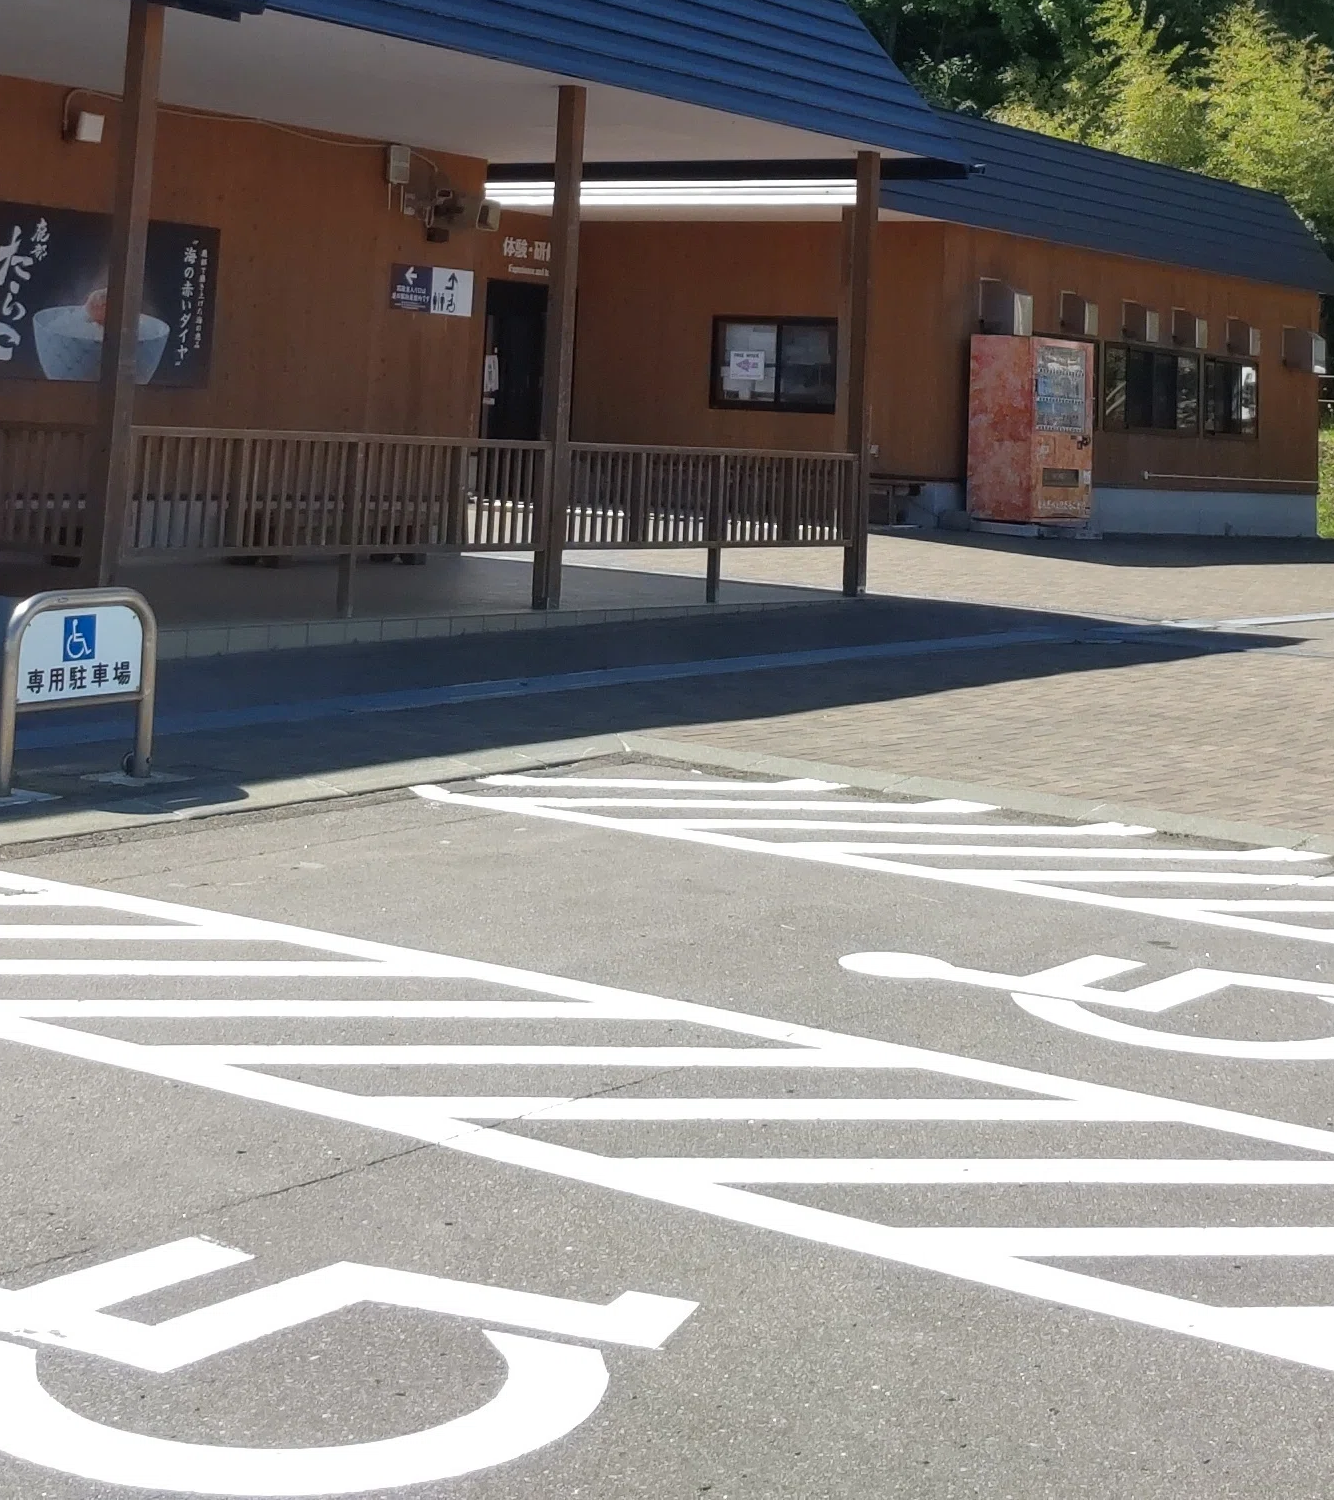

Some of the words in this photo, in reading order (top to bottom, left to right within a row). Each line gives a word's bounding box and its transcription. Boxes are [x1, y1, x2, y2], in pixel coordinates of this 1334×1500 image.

[30, 217, 51, 262] 鹿部
[26, 661, 132, 694] 専用駐車場
